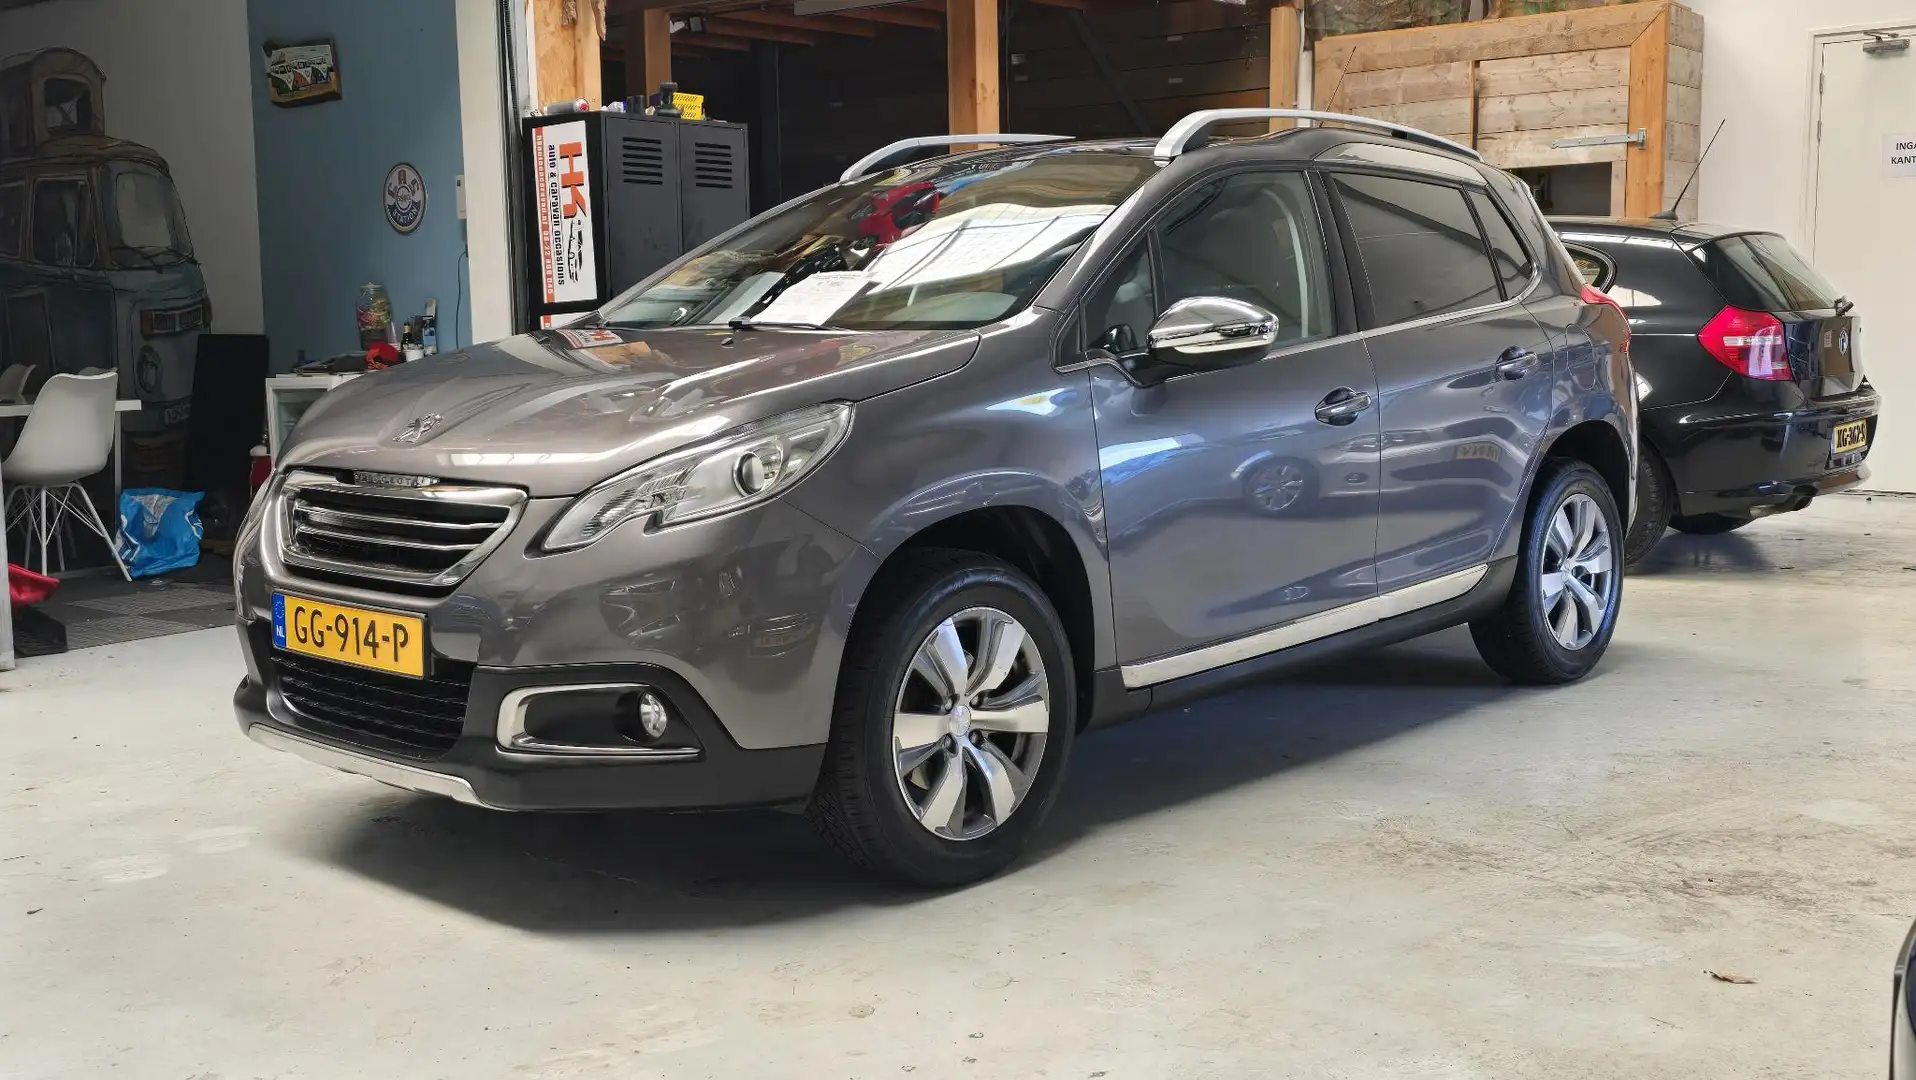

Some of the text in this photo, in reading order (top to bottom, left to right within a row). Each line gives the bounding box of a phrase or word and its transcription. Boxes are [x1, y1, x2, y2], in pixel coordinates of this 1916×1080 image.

[548, 144, 557, 168] auto
[559, 142, 587, 219] HK
[392, 206, 418, 224] STATION
[550, 182, 560, 226] caravan
[554, 230, 565, 286] occasions
[276, 624, 285, 638] NL
[294, 606, 409, 662] GG-914-P
